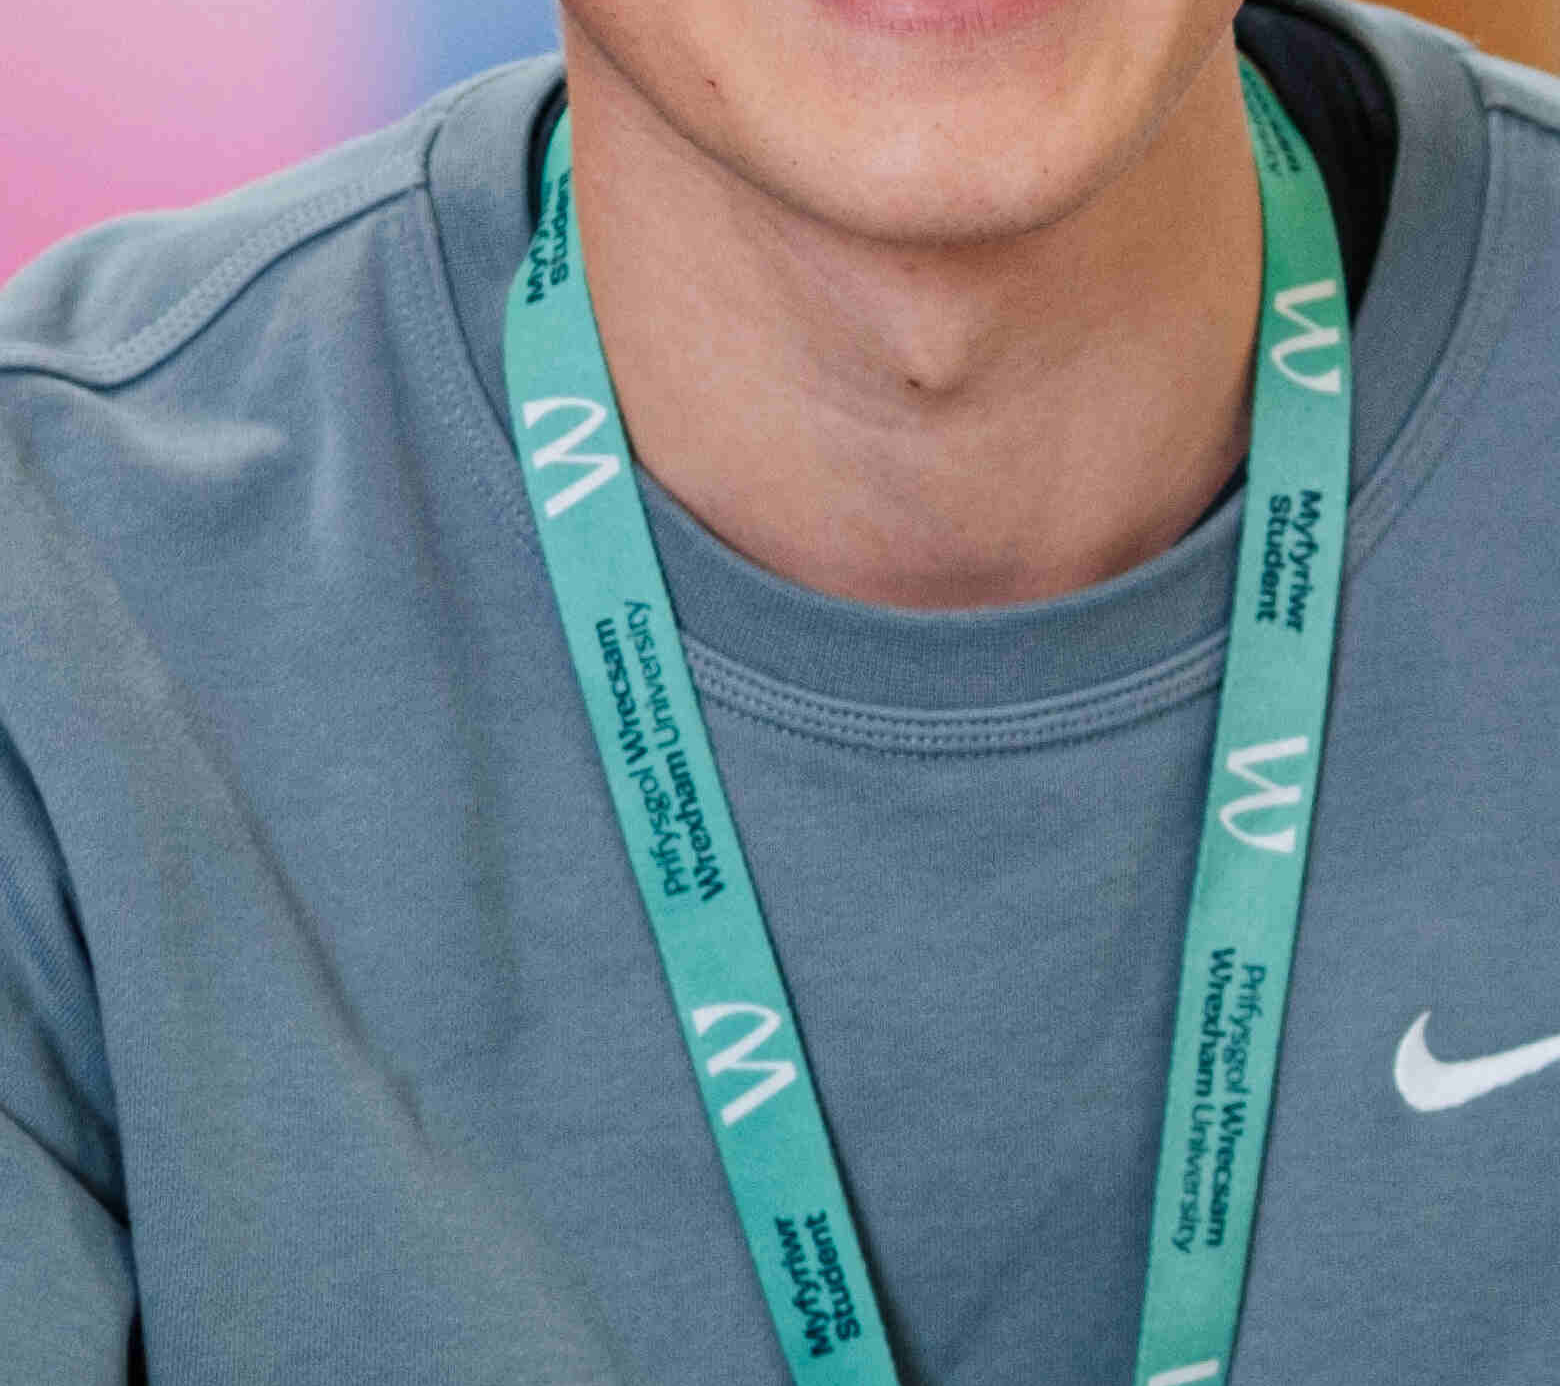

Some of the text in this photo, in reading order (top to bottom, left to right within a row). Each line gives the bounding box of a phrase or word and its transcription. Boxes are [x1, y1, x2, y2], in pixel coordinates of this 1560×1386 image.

[1271, 280, 1341, 393] W
[521, 396, 621, 518] W
[1255, 493, 1292, 623] Student
[1285, 489, 1323, 634] Myfyriwr
[595, 617, 691, 898] Prifysgol Wrecsam
[624, 597, 727, 902] Wrexham University
[1219, 734, 1309, 854] W
[692, 1001, 798, 1128] W
[1171, 946, 1237, 1254] Wrexham University
[1204, 962, 1267, 1249] Prifysgol Wrecsam
[775, 1217, 835, 1358] Myfyriwr
[805, 1209, 863, 1342] Student
